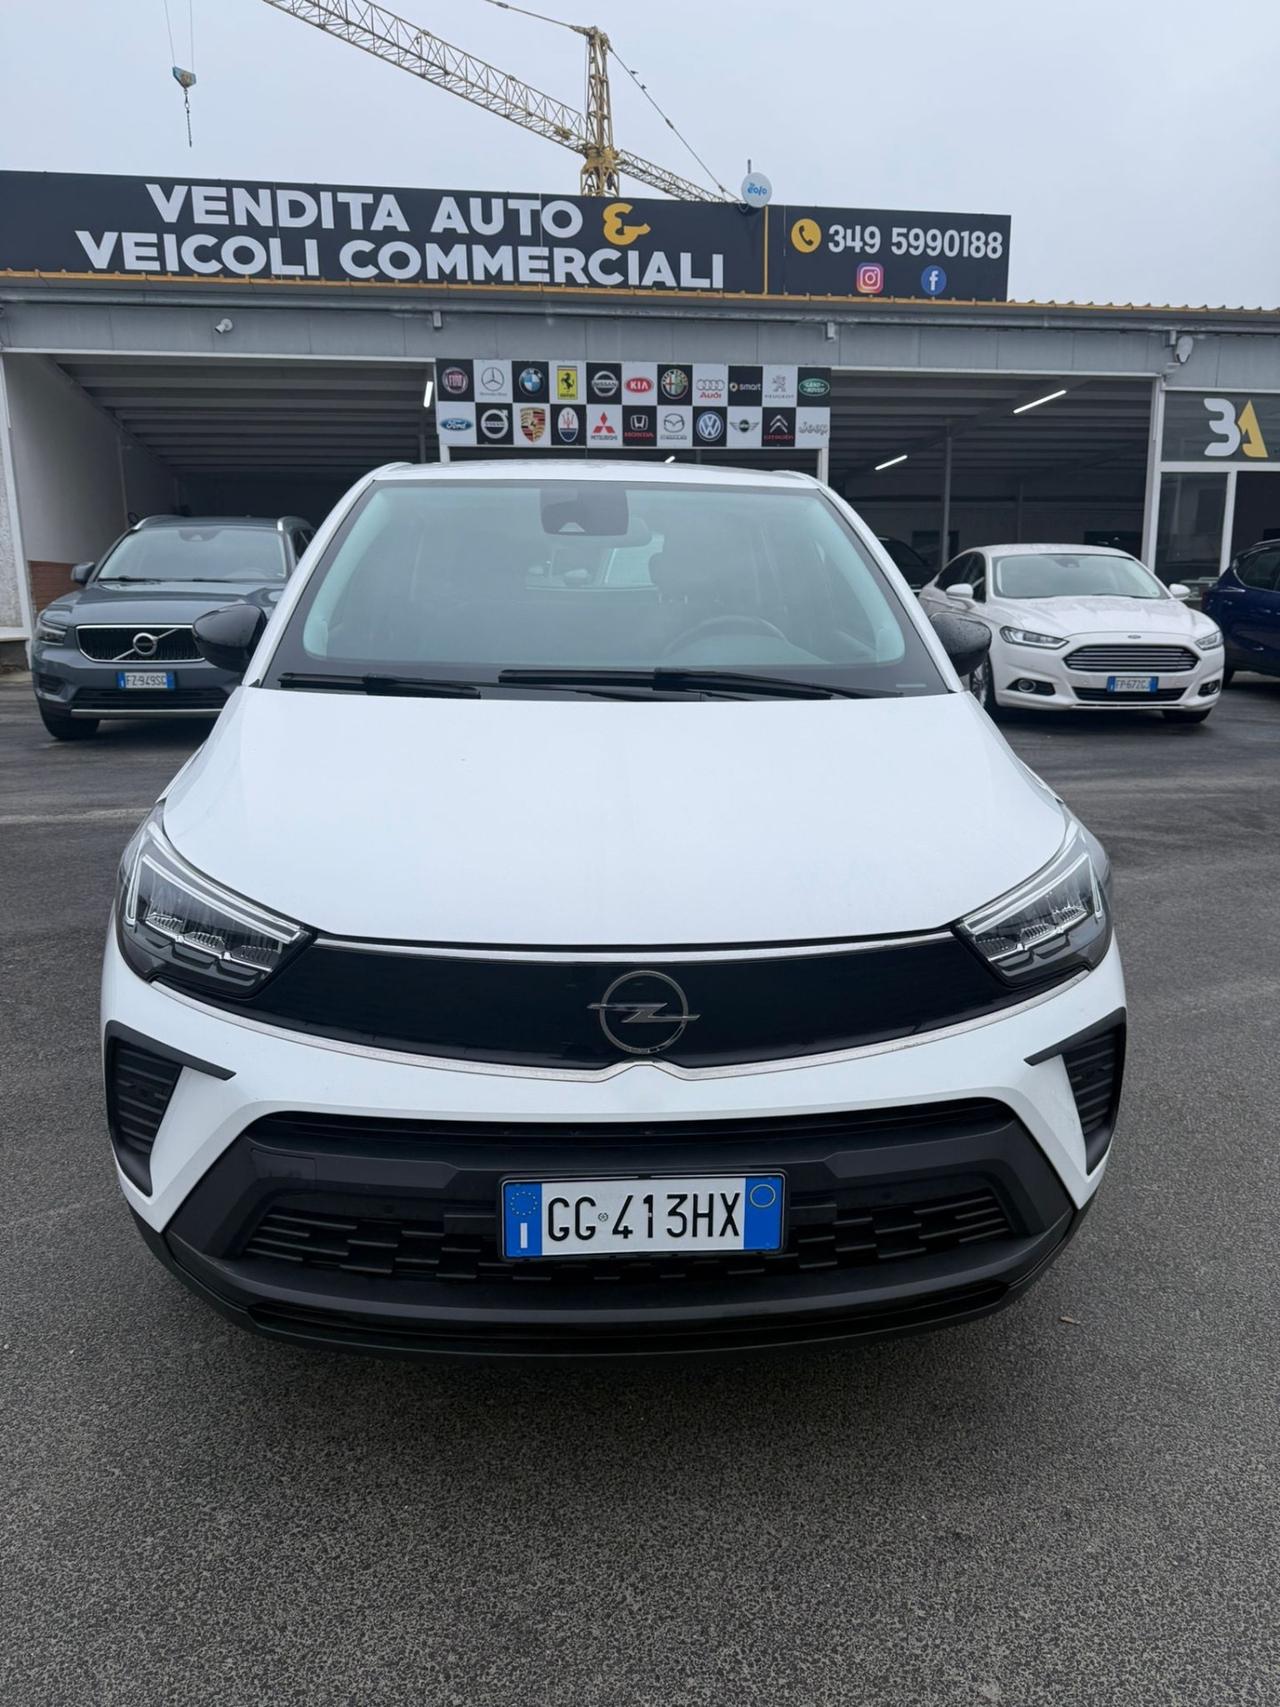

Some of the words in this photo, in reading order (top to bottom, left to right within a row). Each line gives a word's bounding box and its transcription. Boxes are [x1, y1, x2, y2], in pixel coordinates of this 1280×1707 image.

[145, 184, 410, 232] VENDITA
[430, 196, 583, 239] AUTO
[602, 202, 651, 246] &
[828, 224, 881, 254] 349
[890, 226, 1003, 259] 5990188
[75, 230, 320, 277] VEICOLI
[339, 240, 724, 289] COMMERCIALI
[630, 381, 648, 390] KIA
[739, 383, 762, 391] smart
